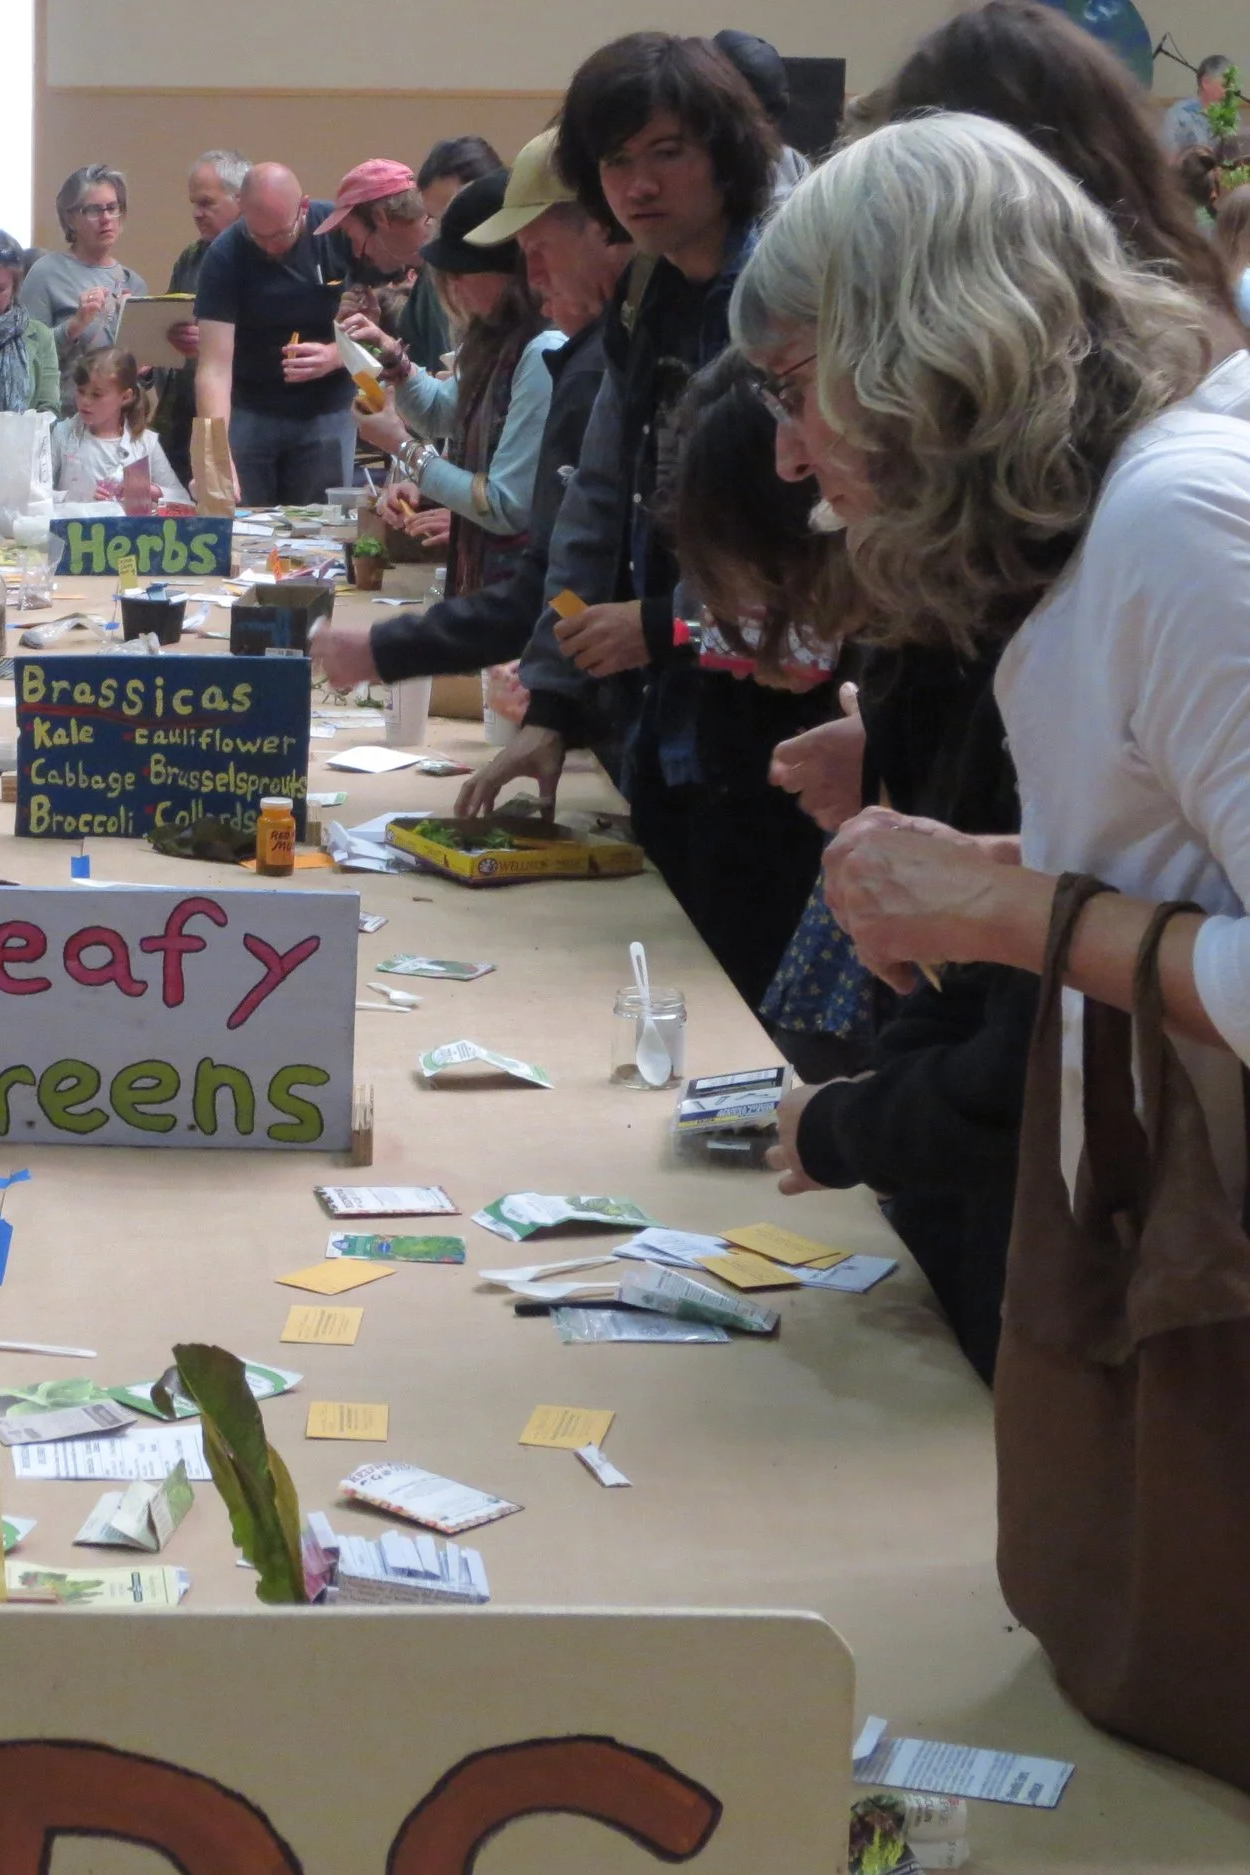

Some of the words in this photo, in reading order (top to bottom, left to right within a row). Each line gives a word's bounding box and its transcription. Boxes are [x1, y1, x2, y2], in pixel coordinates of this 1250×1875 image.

[66, 519, 218, 574] Herbs
[22, 664, 253, 717] Brassicas
[32, 717, 94, 749] Kale
[30, 757, 137, 798] Cabbage
[150, 752, 308, 801] Brusselsprouts
[29, 794, 134, 834] Broccoli
[154, 799, 256, 834] Collrds
